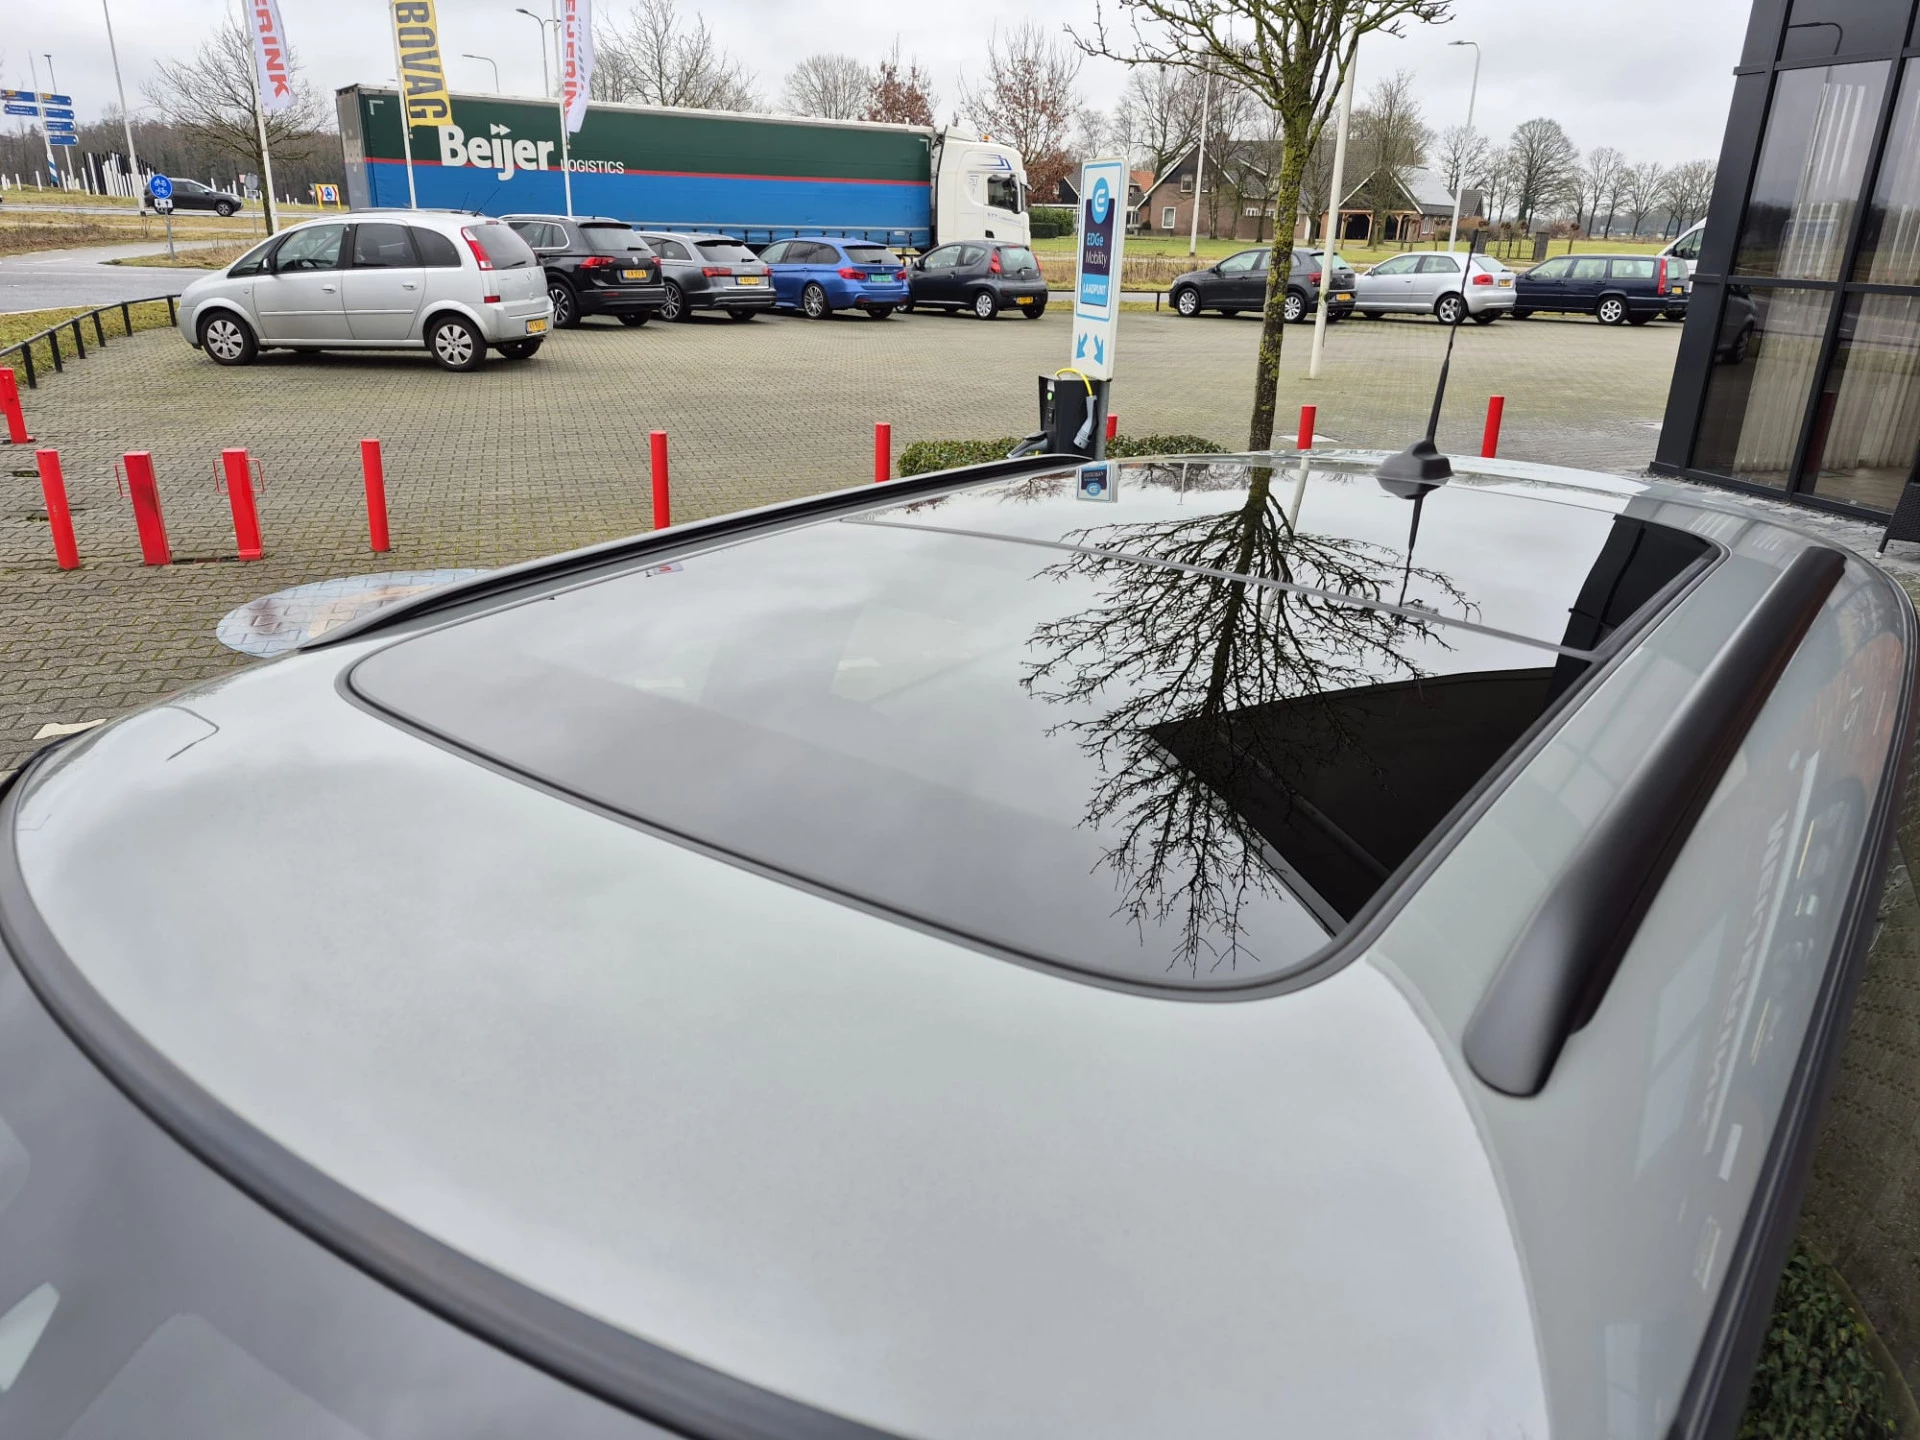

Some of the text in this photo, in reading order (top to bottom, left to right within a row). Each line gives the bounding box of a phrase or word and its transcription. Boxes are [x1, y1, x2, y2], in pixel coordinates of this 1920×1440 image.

[395, 2, 448, 119] BOVAG
[438, 123, 625, 181] Beijer LOGISTICS
[1086, 232, 1104, 247] EDGe
[1085, 250, 1108, 269] Mobility
